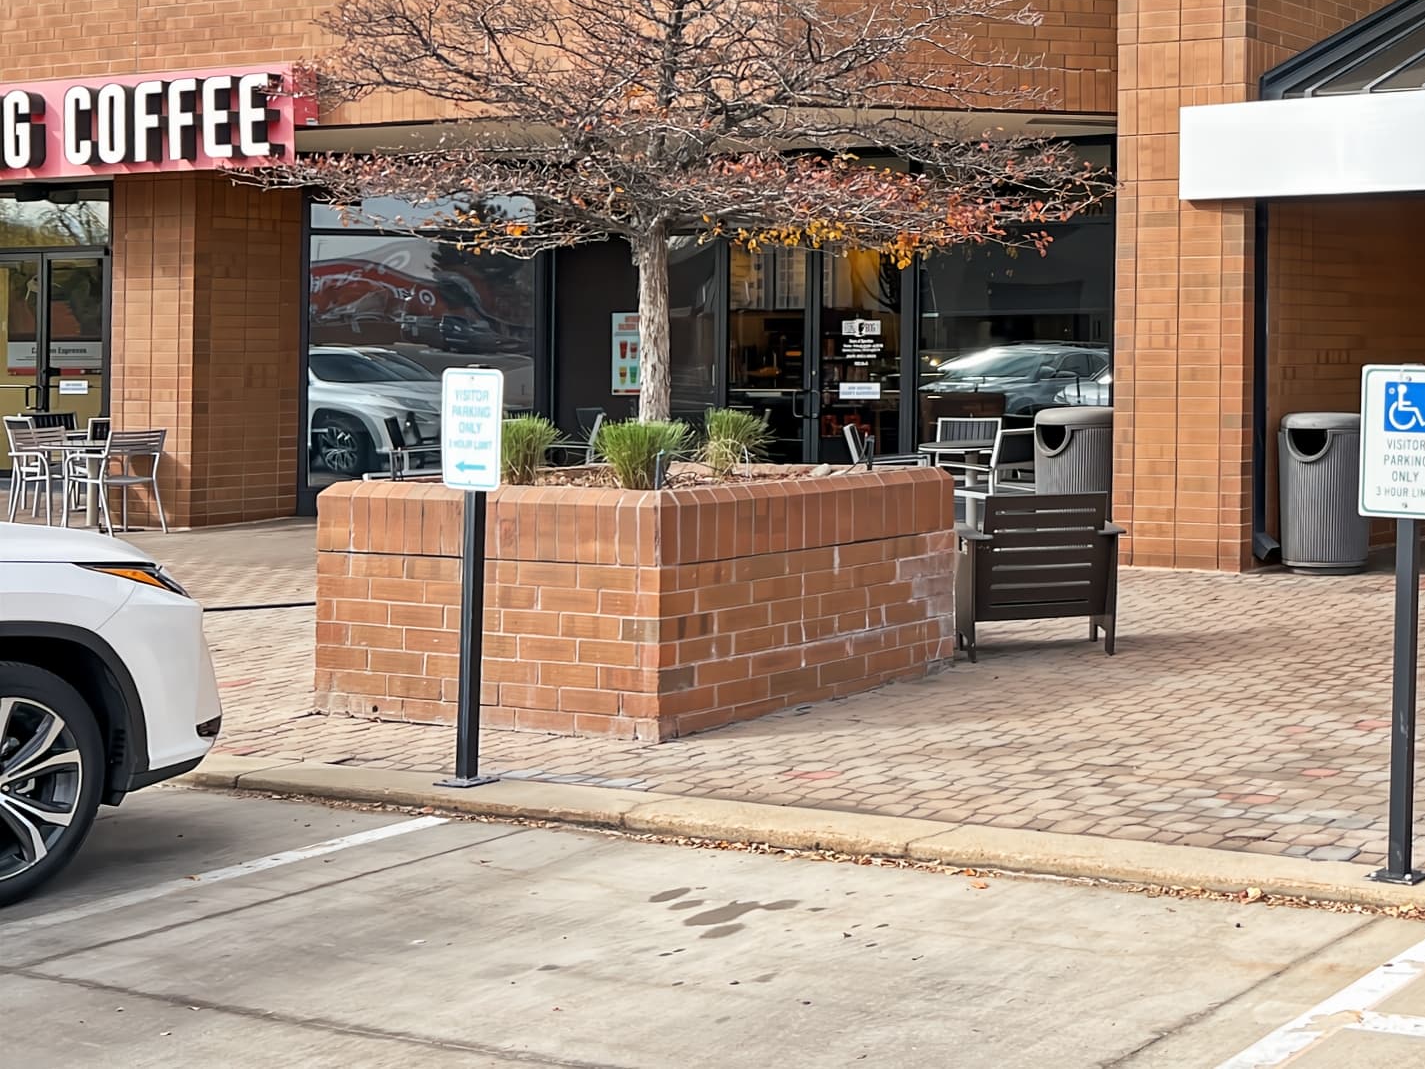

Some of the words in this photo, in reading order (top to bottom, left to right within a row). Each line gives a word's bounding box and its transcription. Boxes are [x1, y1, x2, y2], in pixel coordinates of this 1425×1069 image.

[64, 72, 278, 167] COFFEE
[1387, 439, 1425, 451] VISITOR
[1391, 471, 1420, 483] ONLY
[1376, 486, 1382, 496] 3
[1384, 487, 1409, 497] HOUR
